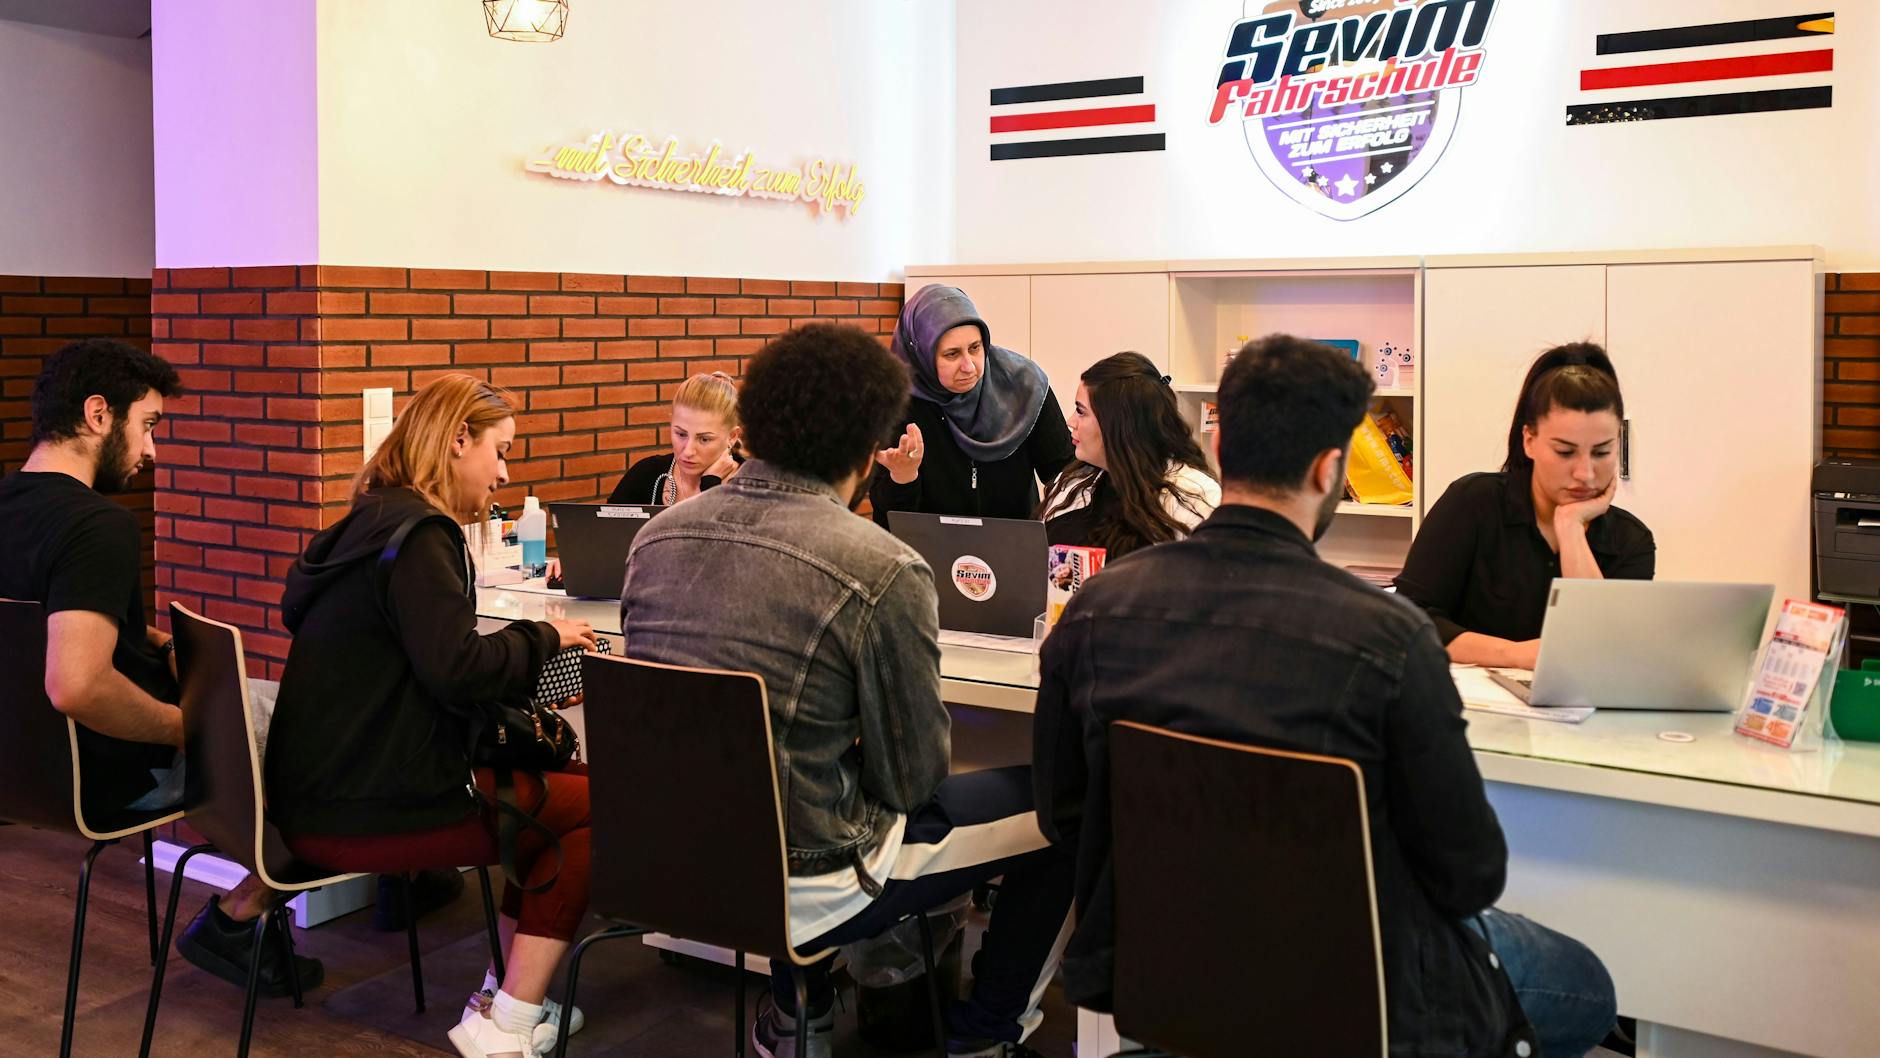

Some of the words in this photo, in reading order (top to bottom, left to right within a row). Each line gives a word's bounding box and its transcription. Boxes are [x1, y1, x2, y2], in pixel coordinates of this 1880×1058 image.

[1209, 47, 1484, 124] Fahrschule
[1279, 127, 1315, 146] MIT
[1317, 110, 1431, 140] SICHERHEIT
[1288, 139, 1333, 158] ZUM
[1336, 128, 1410, 152] ERFOLG
[614, 133, 753, 191] Sicherheit
[752, 168, 802, 196] zum
[804, 158, 865, 216] Erfolg
